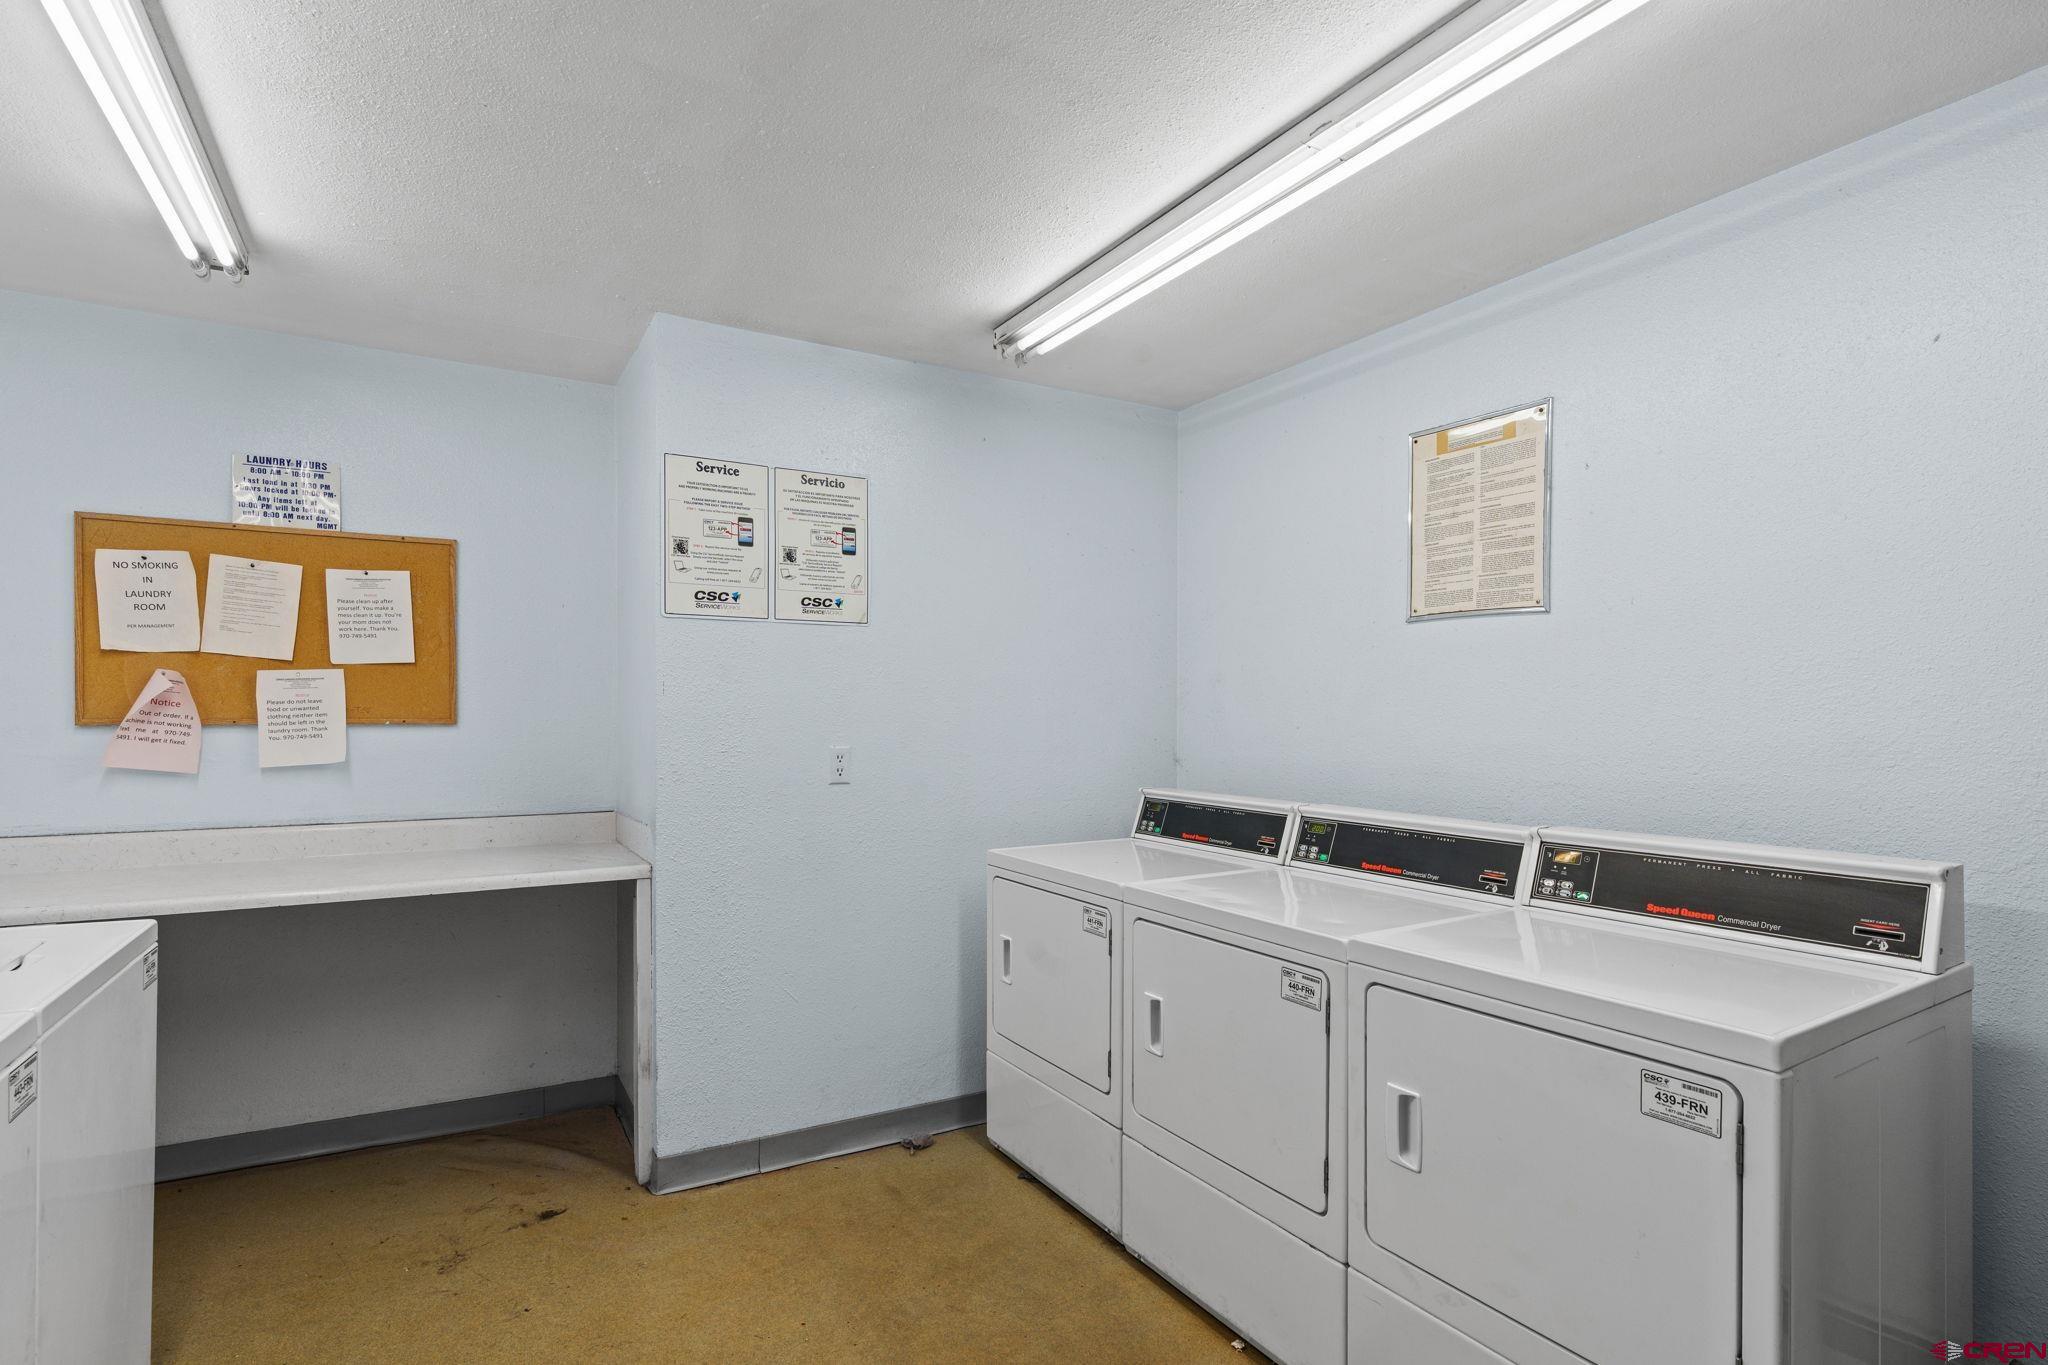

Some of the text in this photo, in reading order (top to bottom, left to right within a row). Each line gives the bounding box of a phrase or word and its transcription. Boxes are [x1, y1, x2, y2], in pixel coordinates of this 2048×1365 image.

[246, 455, 291, 467] LAUNDRY
[696, 461, 740, 476] Service
[800, 475, 845, 489] Servicio
[264, 486, 288, 494] locked
[694, 591, 729, 601] CSC
[801, 597, 833, 607] CSC
[150, 698, 181, 707] Notice
[1643, 858, 1687, 867] PERMANENT
[1361, 862, 1381, 870] Speed
[1403, 869, 1426, 878] Commercial
[1427, 872, 1439, 881] Dryer
[1646, 903, 1781, 932] Speed Queen Commercial Dryer
[1288, 982, 1315, 996] 440-FRN
[1644, 1073, 1663, 1083] CSC
[1655, 1091, 1709, 1115] 439-FRN
